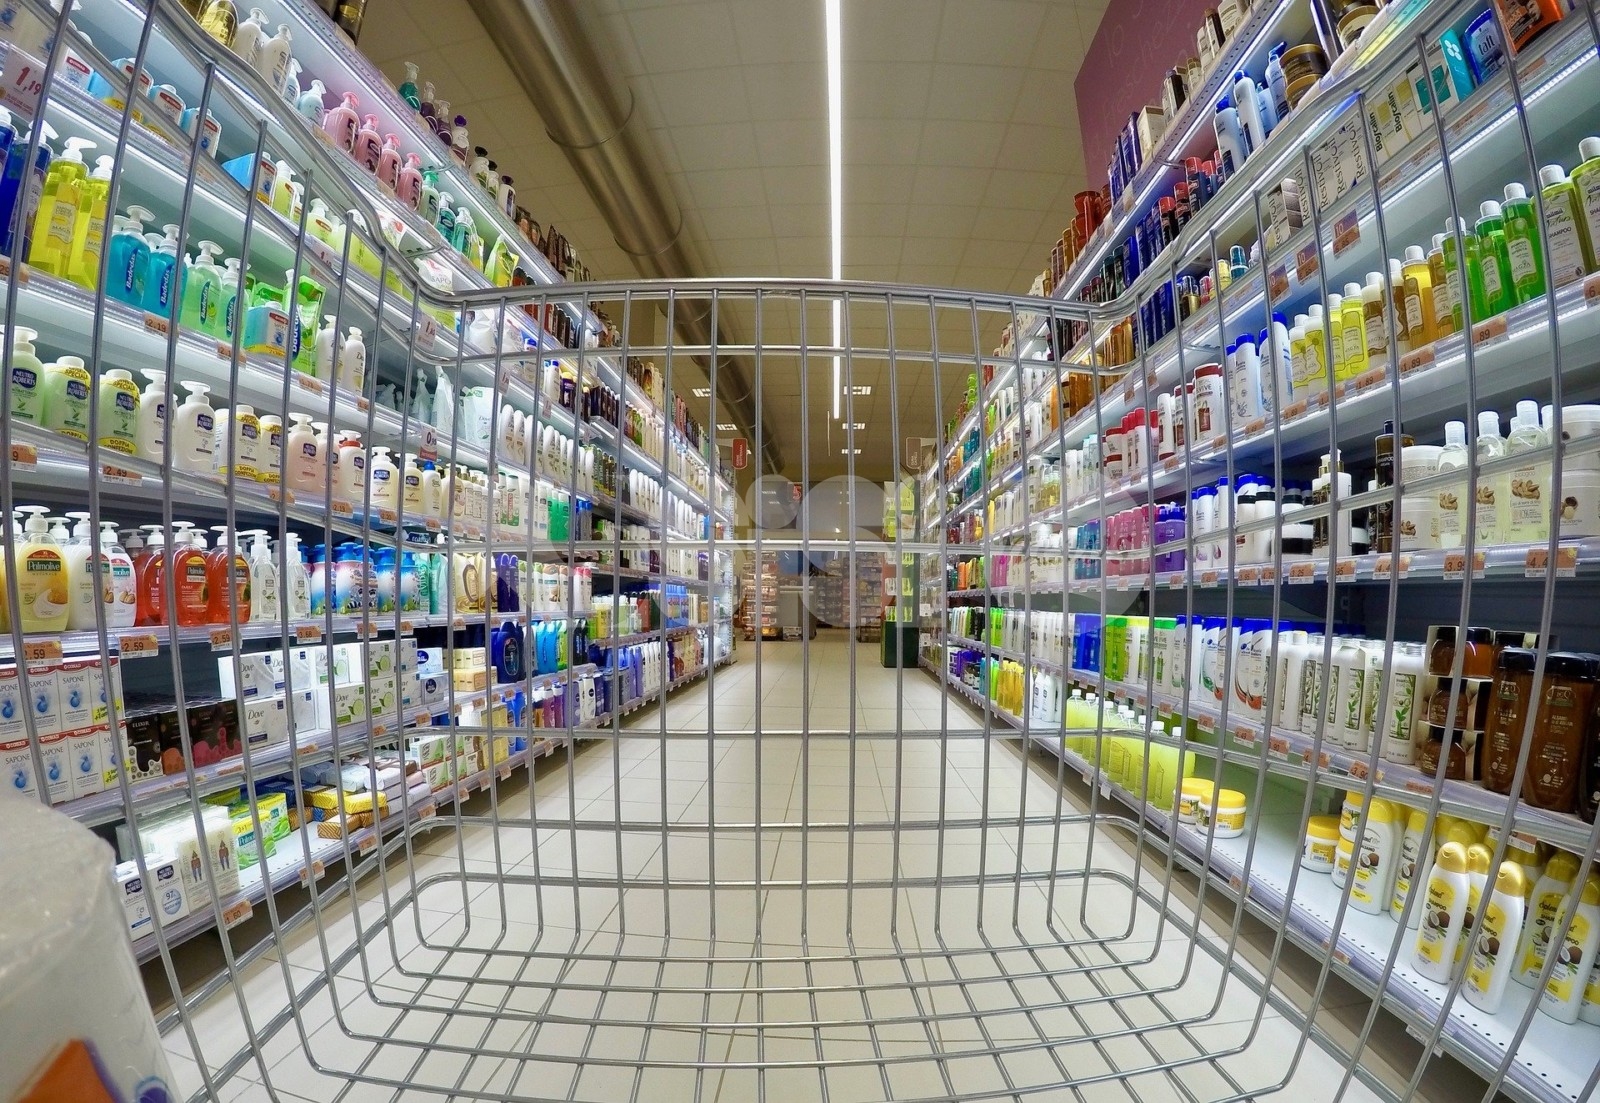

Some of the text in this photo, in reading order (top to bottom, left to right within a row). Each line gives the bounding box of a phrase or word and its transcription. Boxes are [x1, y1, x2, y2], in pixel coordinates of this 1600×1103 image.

[126, 253, 136, 288] Badedas
[28, 561, 60, 571] Palmolive
[124, 642, 144, 652] 2.59
[247, 709, 264, 720] Dove
